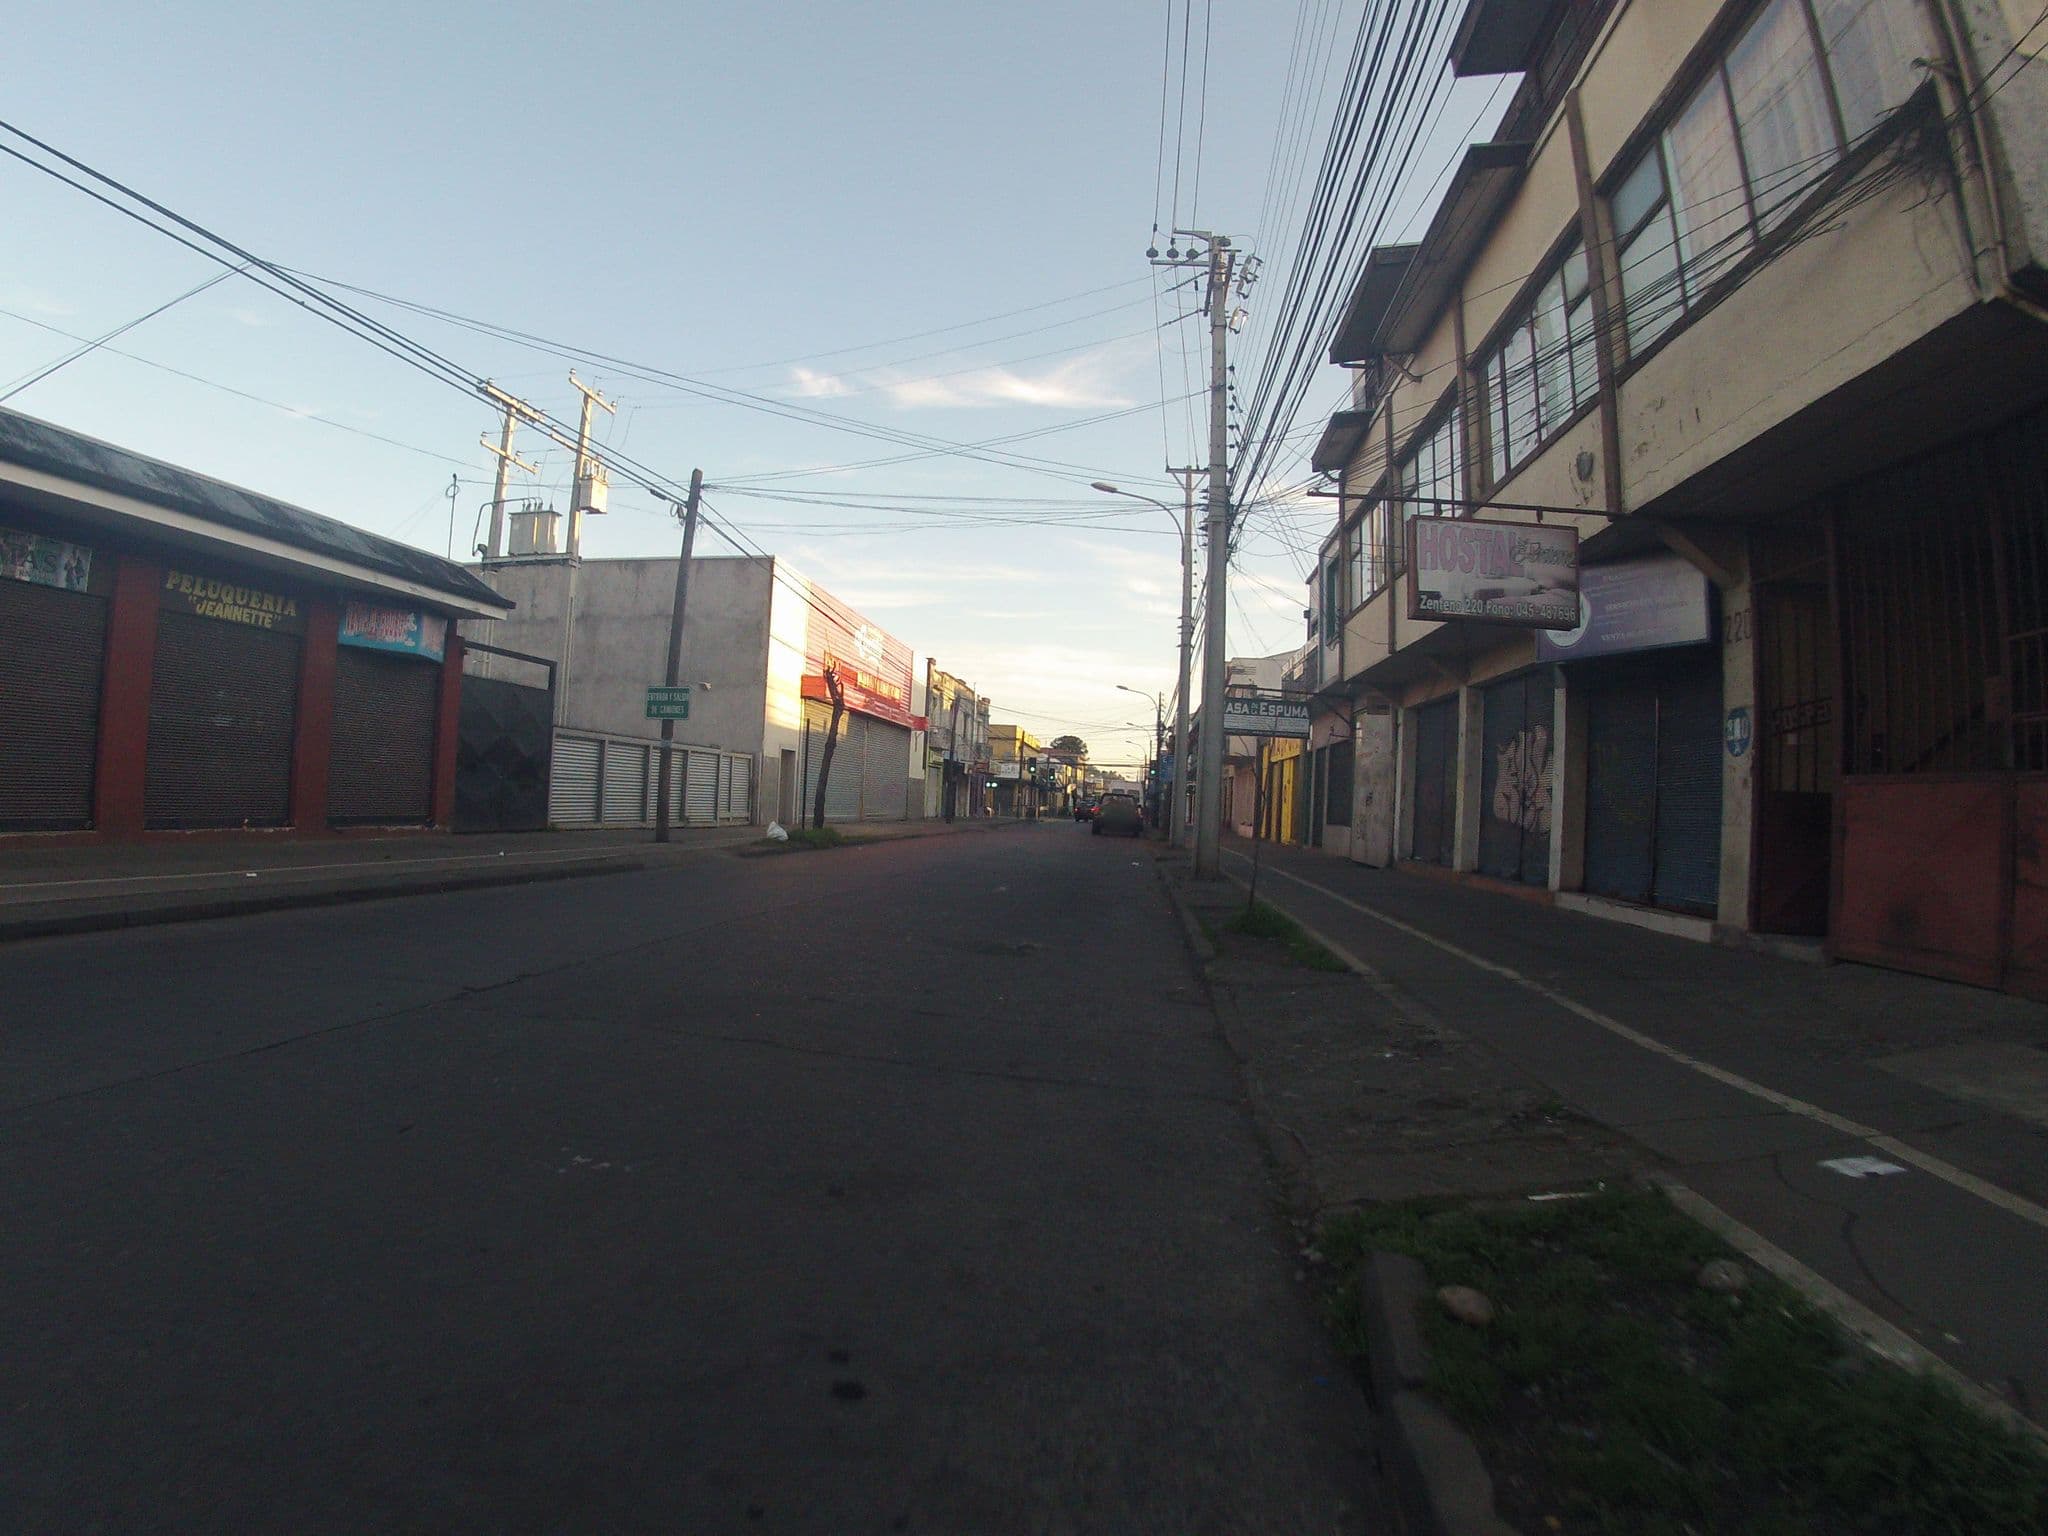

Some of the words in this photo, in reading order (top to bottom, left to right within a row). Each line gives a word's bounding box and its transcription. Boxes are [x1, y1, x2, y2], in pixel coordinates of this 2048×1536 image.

[1419, 524, 1524, 577] HOSTAL
[166, 568, 297, 617] PELUQUERIA
[1466, 599, 1482, 614] 220
[1224, 701, 1250, 715] ASA
[1259, 702, 1309, 718] ESPUMA
